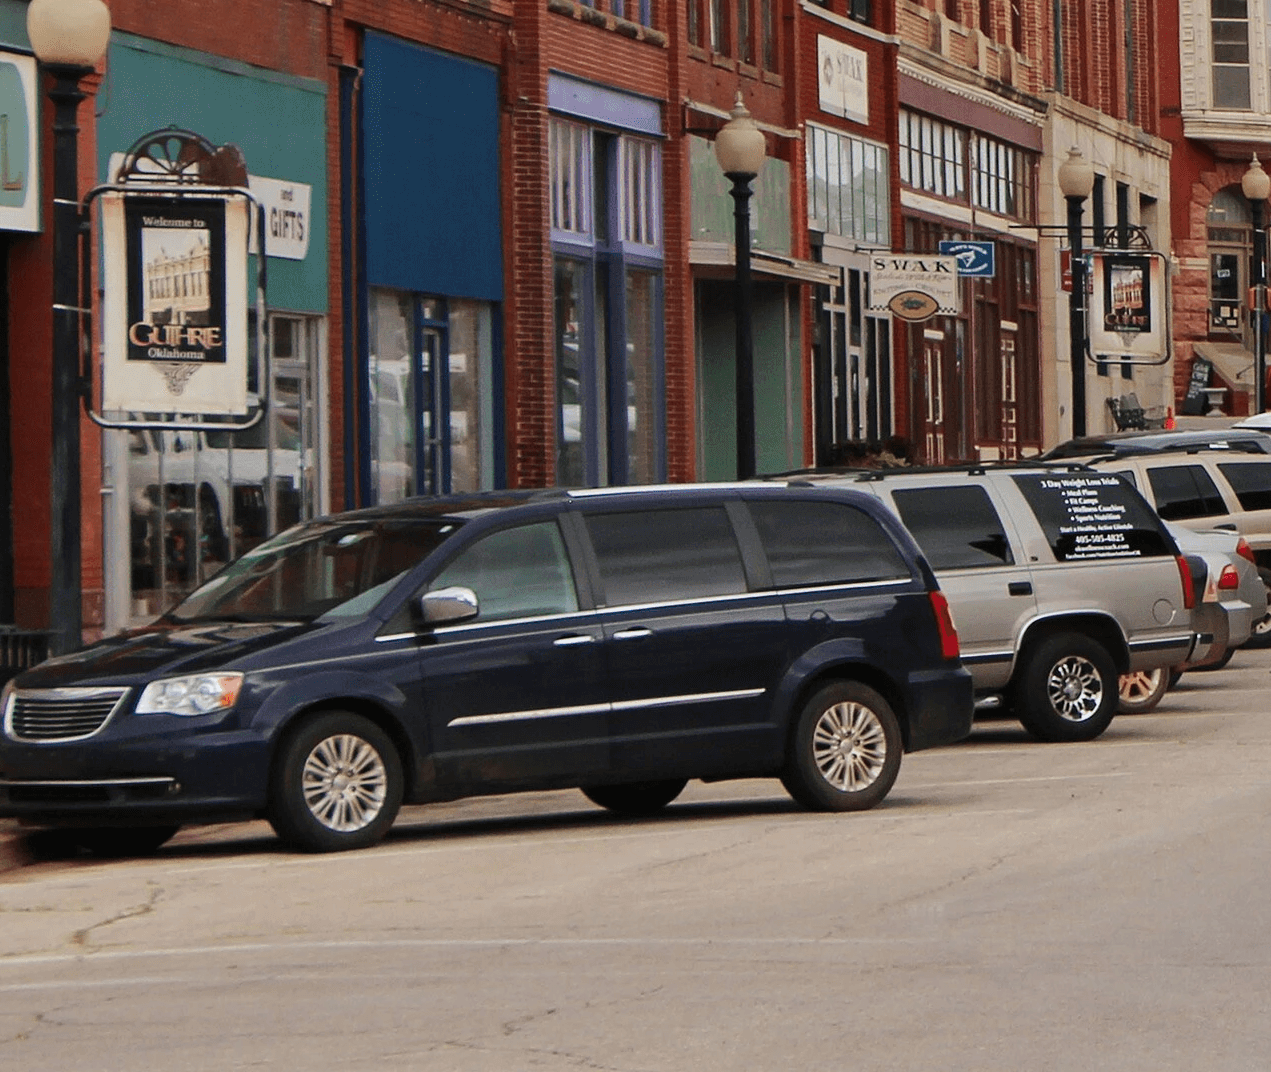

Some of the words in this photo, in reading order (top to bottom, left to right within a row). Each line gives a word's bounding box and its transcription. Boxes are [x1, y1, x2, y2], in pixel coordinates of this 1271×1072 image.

[142, 216, 190, 228] Welcome
[193, 218, 206, 228] to
[270, 207, 304, 241] GIFTS
[873, 258, 953, 273] SWAK
[129, 322, 222, 349] GUTHRIE
[147, 347, 206, 359] Oklahoma
[1047, 480, 1061, 488] Day
[1061, 478, 1086, 488] Weight
[1086, 478, 1101, 486] Loss
[1101, 477, 1119, 486] Trials
[1098, 505, 1126, 513] Coaching
[1075, 515, 1094, 523] Sports
